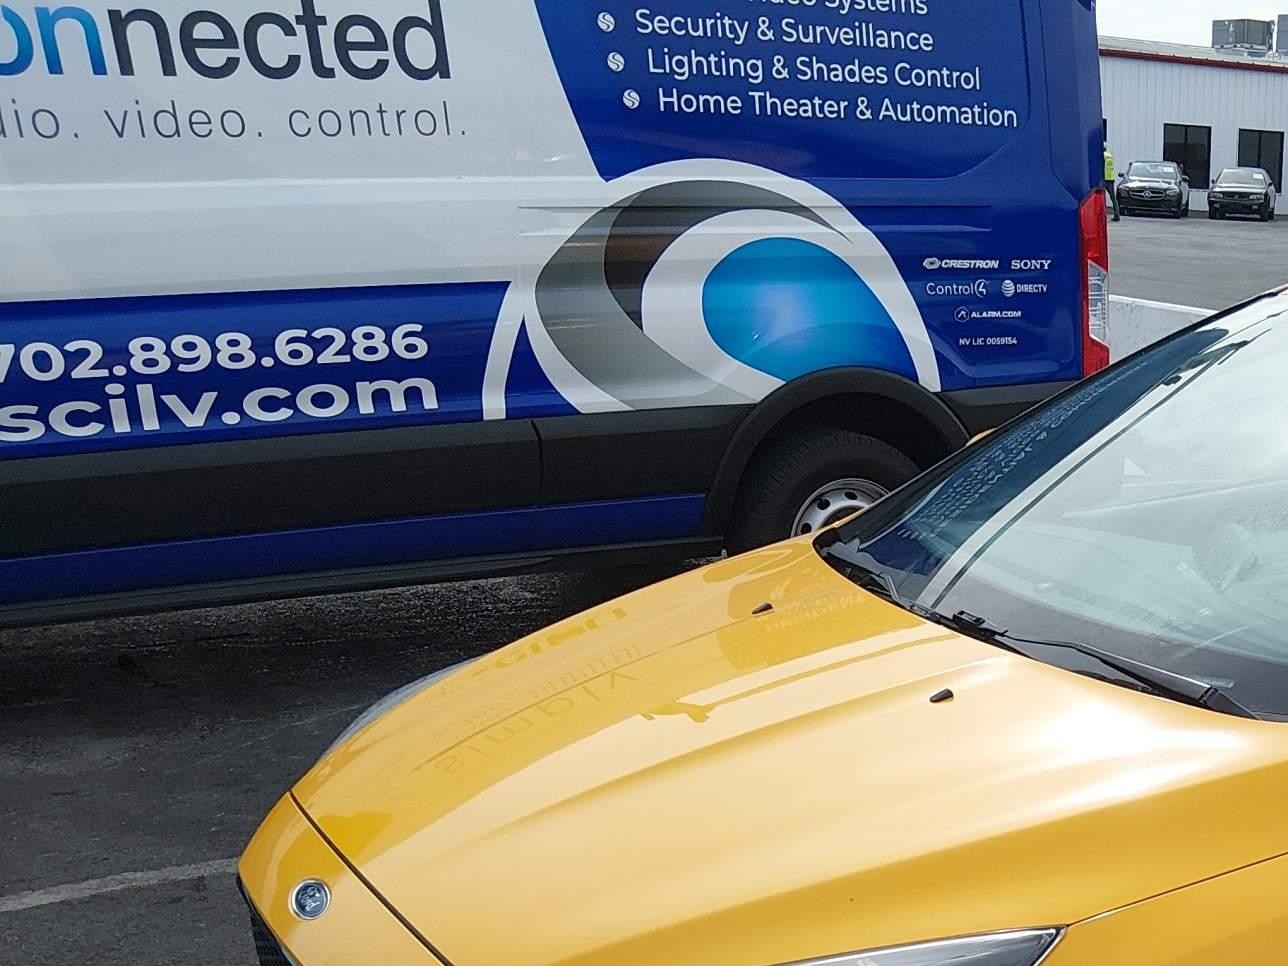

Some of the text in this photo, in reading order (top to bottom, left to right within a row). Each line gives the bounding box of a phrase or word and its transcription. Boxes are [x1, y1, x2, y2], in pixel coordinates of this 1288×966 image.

[636, 9, 934, 51] Security & Surveillance
[647, 48, 980, 91] Lighting & Shades Control
[104, 99, 262, 139] video.
[288, 100, 466, 138] control.
[658, 88, 1018, 129] Home Theater & Automation
[941, 259, 1052, 270] CRESTRON SONY
[1016, 284, 1048, 293] DIRECTV
[959, 337, 1018, 346] NV LIC 0059154
[0, 377, 439, 442] scilv.com
